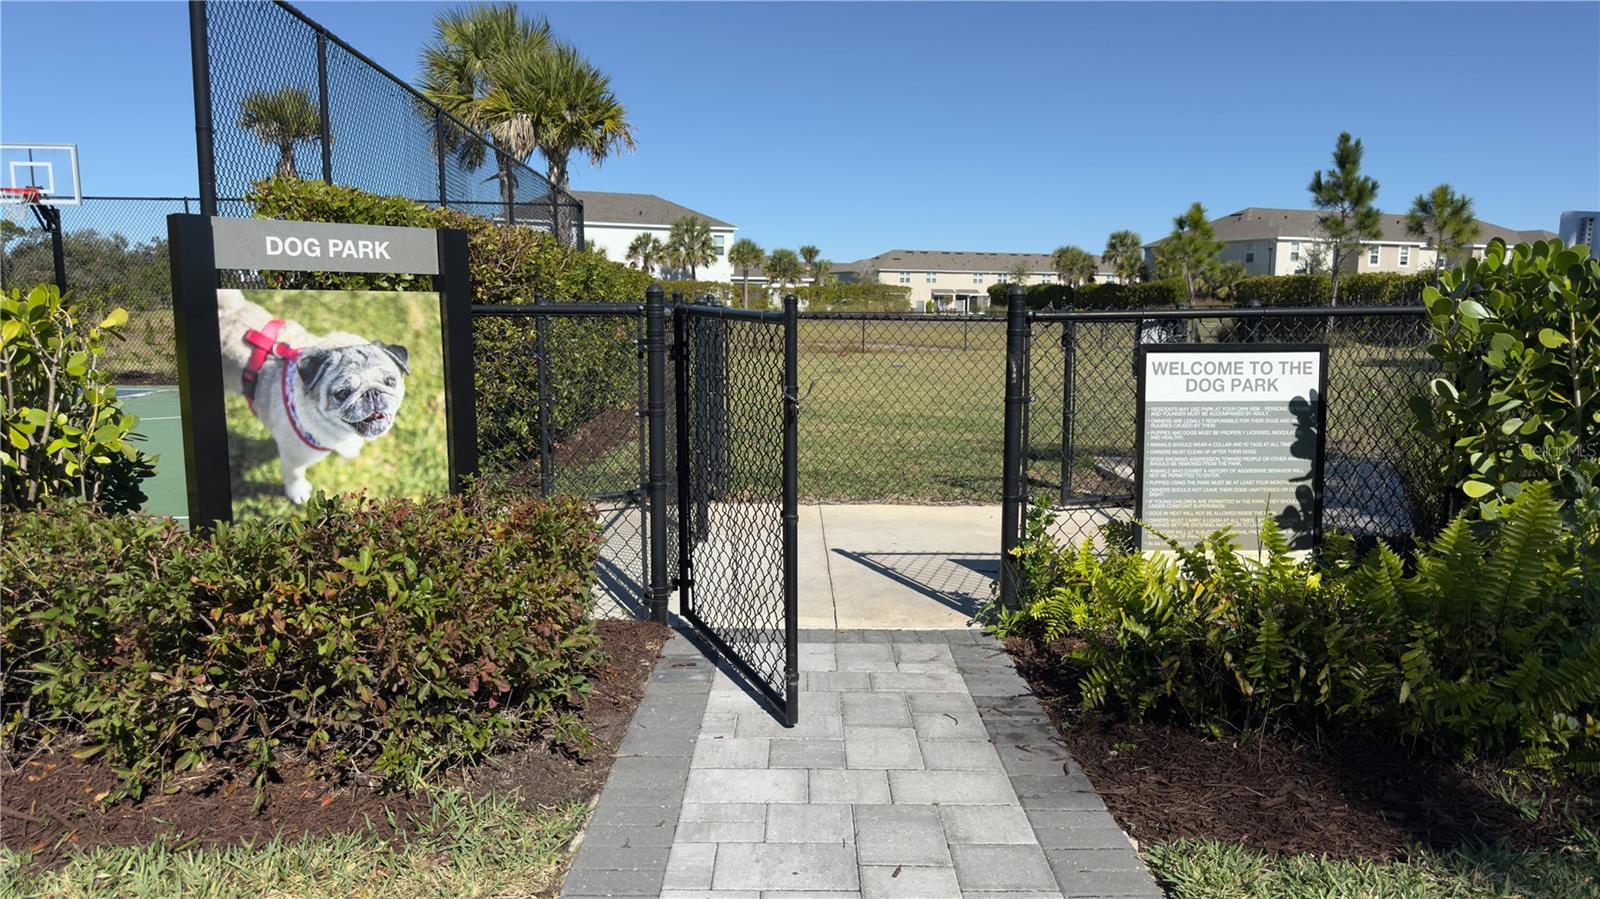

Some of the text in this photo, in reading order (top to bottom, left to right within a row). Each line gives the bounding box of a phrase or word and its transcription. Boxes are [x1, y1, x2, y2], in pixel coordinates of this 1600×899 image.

[265, 236, 391, 259] DOG PARK
[1152, 361, 1313, 376] WELCOME TO THE
[1186, 378, 1279, 392] DOG PARK
